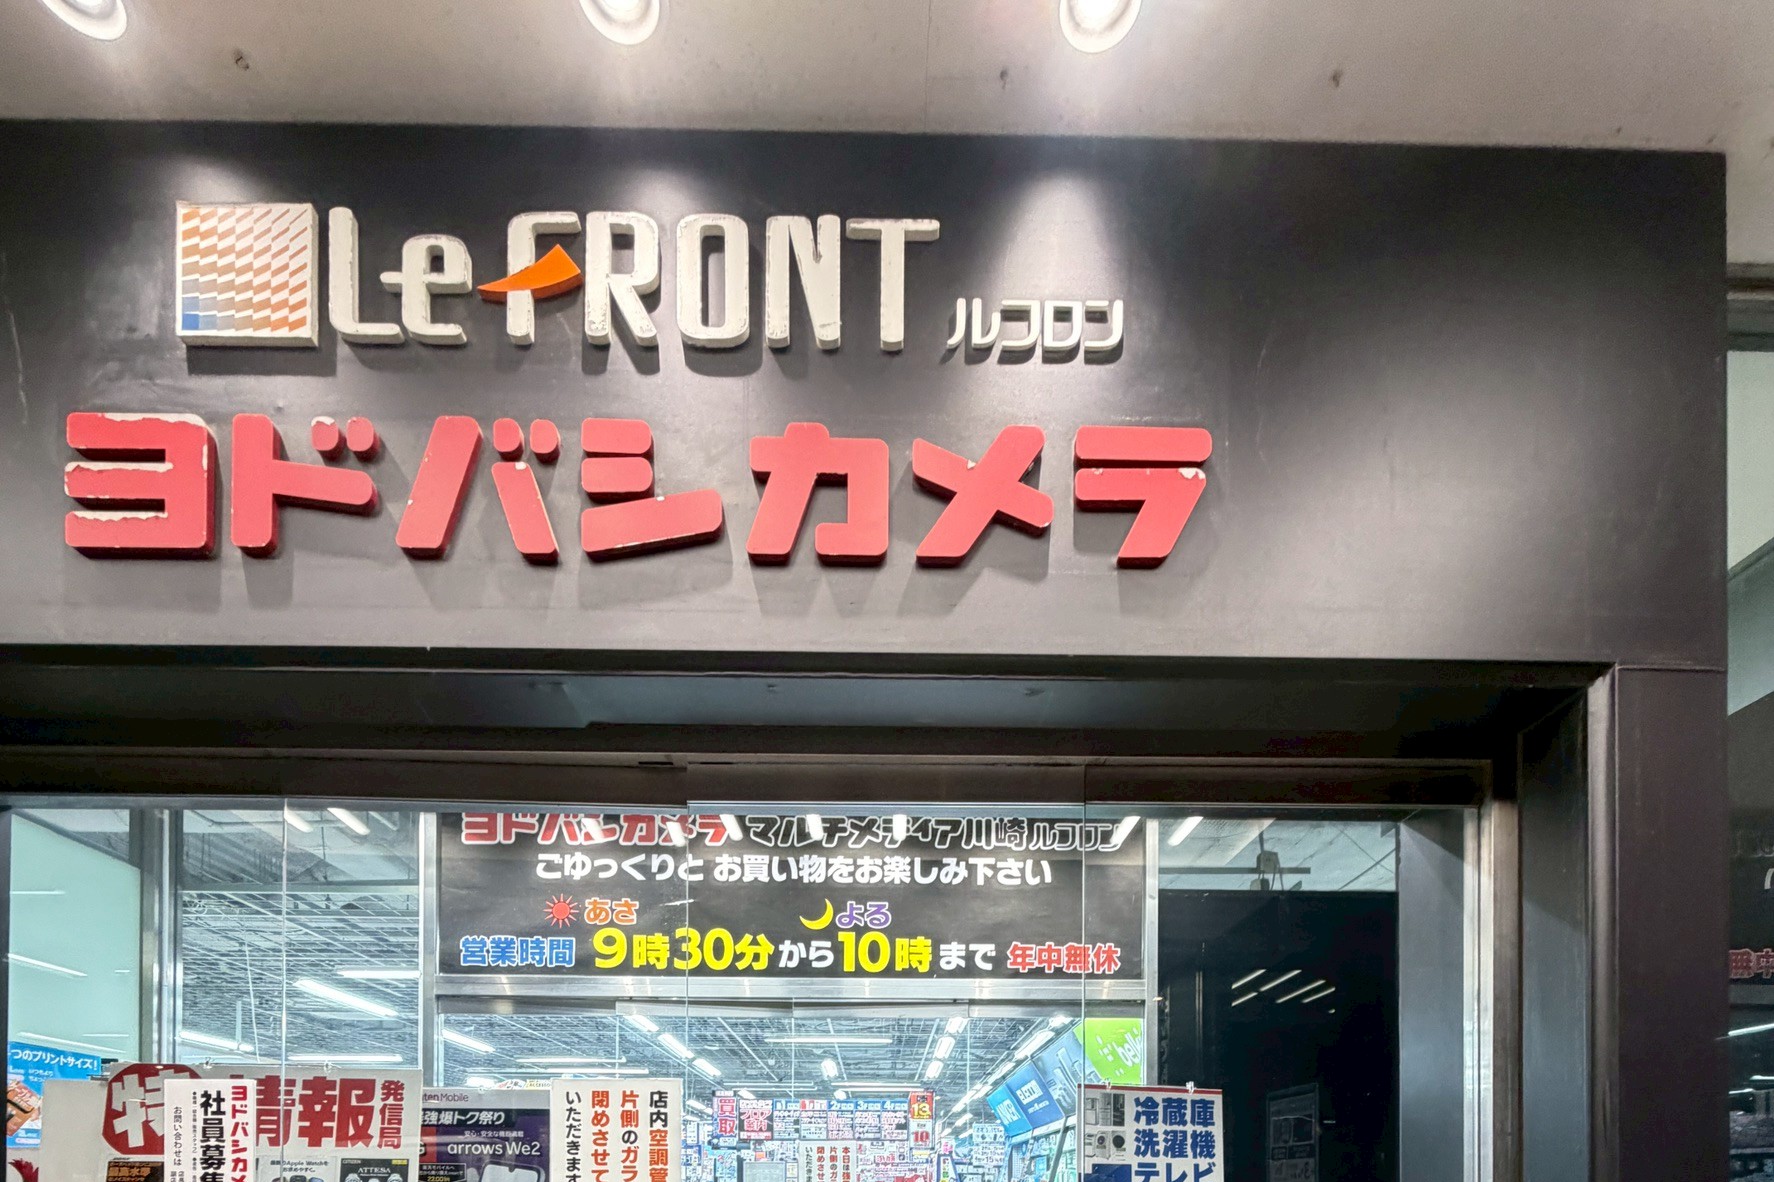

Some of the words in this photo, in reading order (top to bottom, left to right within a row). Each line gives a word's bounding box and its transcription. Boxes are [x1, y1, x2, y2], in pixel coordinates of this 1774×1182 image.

[328, 206, 474, 345] Le
[480, 210, 941, 353] FRONT
[63, 411, 1213, 566] ヨドバシカメラ
[535, 853, 704, 882] ごゆっくりと
[713, 853, 1052, 886] お買い物をお楽しみ下さい
[584, 897, 640, 926] あさ
[835, 900, 892, 929] よる
[459, 935, 577, 968] 営業時間
[1006, 942, 1121, 974] 年中無休
[440, 1092, 469, 1102] Mobile
[1134, 1096, 1215, 1128] 冷蔵庫
[377, 1079, 405, 1150] 発信局
[718, 1098, 736, 1136] 買取
[173, 1106, 183, 1166] お問い合わせは
[447, 1143, 503, 1155] arrows
[505, 1141, 541, 1156] We2
[1134, 1128, 1216, 1159] 洗濯機
